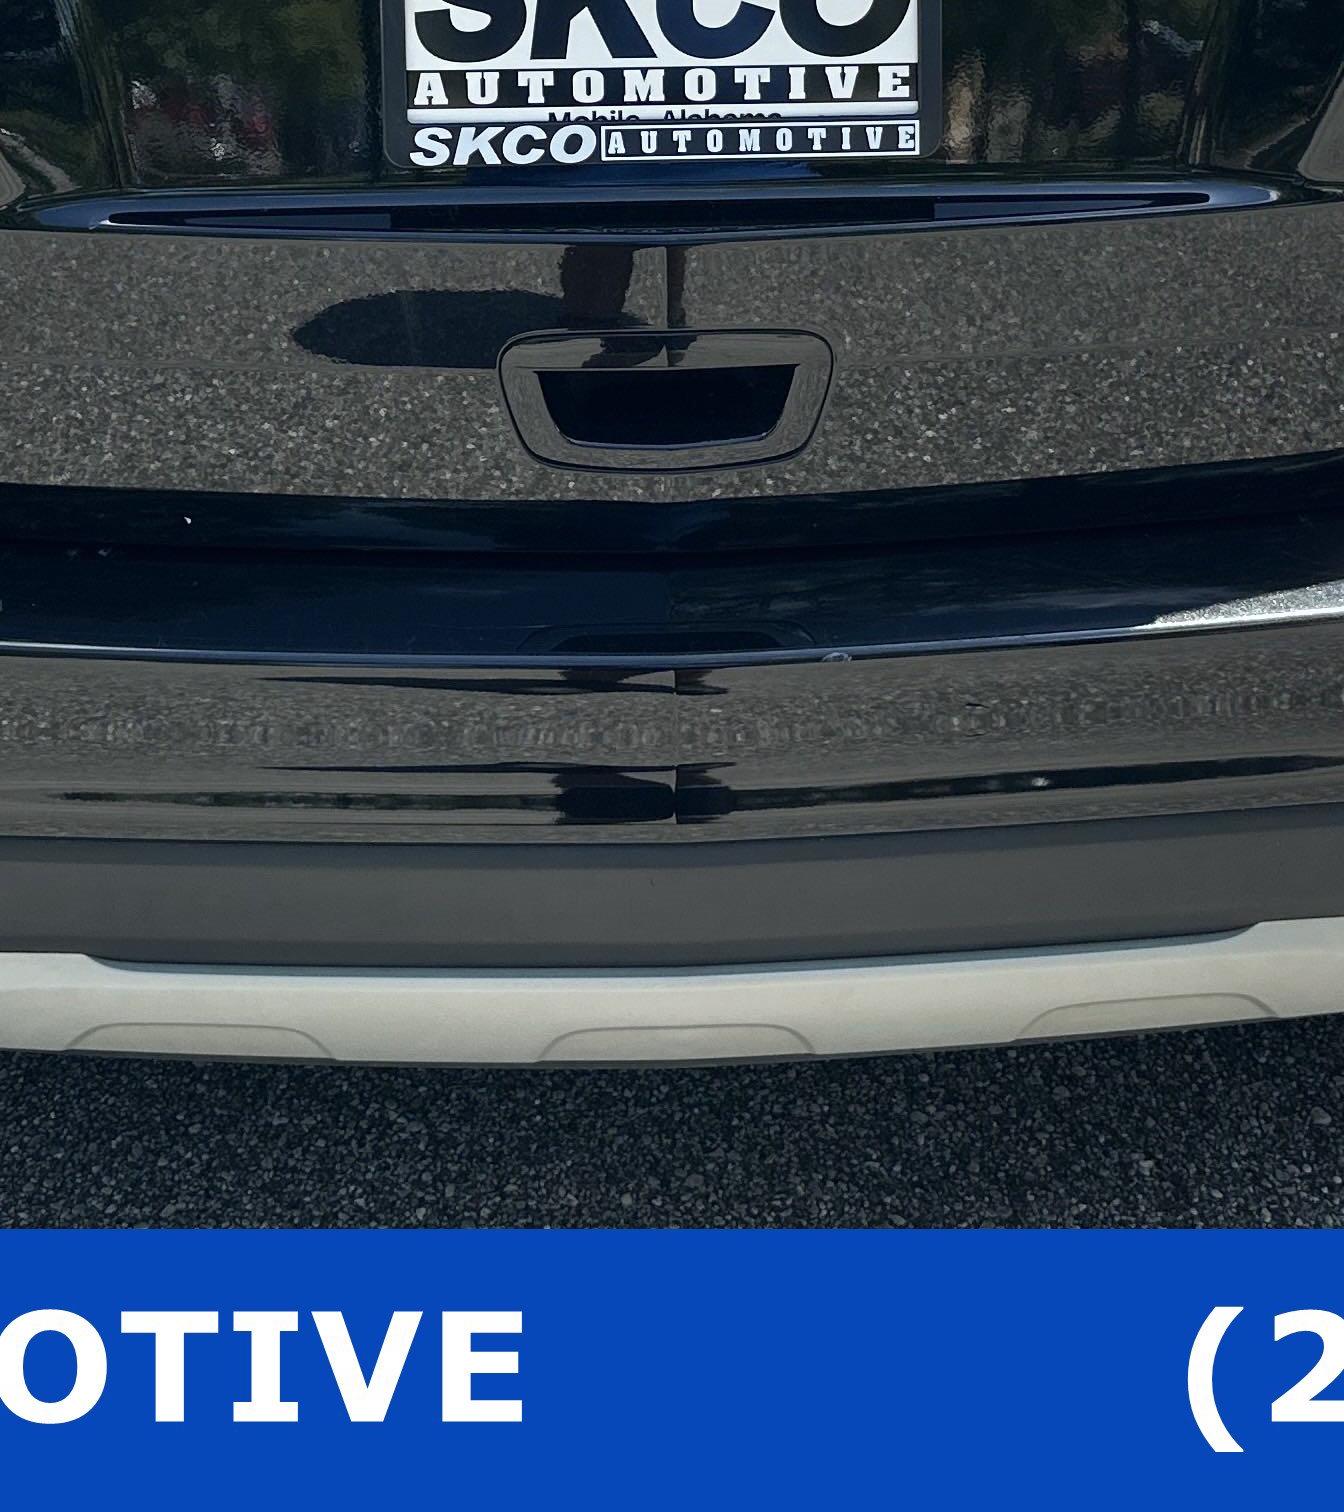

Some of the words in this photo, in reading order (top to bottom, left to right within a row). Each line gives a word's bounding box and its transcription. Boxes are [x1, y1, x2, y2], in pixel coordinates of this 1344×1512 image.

[413, 65, 910, 105] AUTOMOTIVE
[409, 124, 596, 165] SKCO
[607, 124, 916, 154] AUTOMOTIVE
